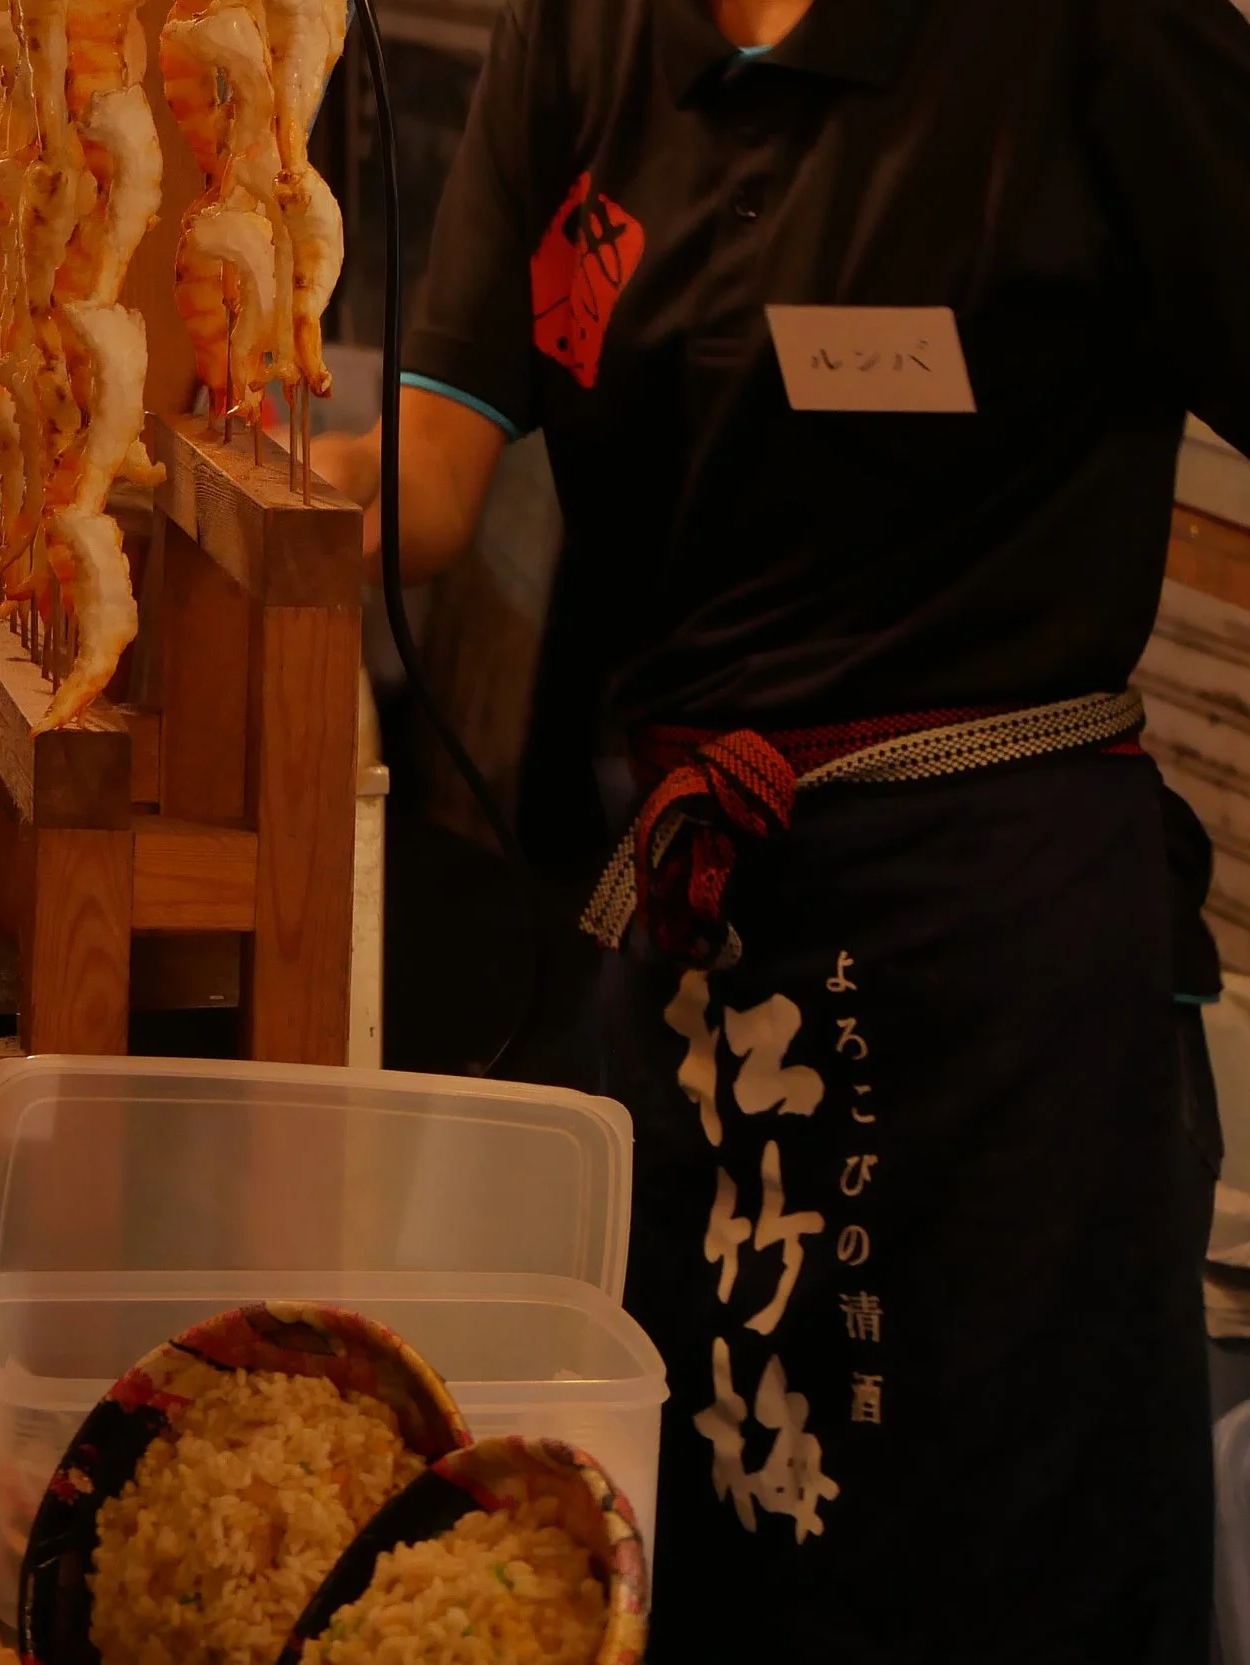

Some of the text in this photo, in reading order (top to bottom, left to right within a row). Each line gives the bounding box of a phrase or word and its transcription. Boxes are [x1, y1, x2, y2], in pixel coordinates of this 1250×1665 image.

[663, 968, 841, 1545] 松竹梅
[826, 949, 883, 1426] よろこびの清酒
